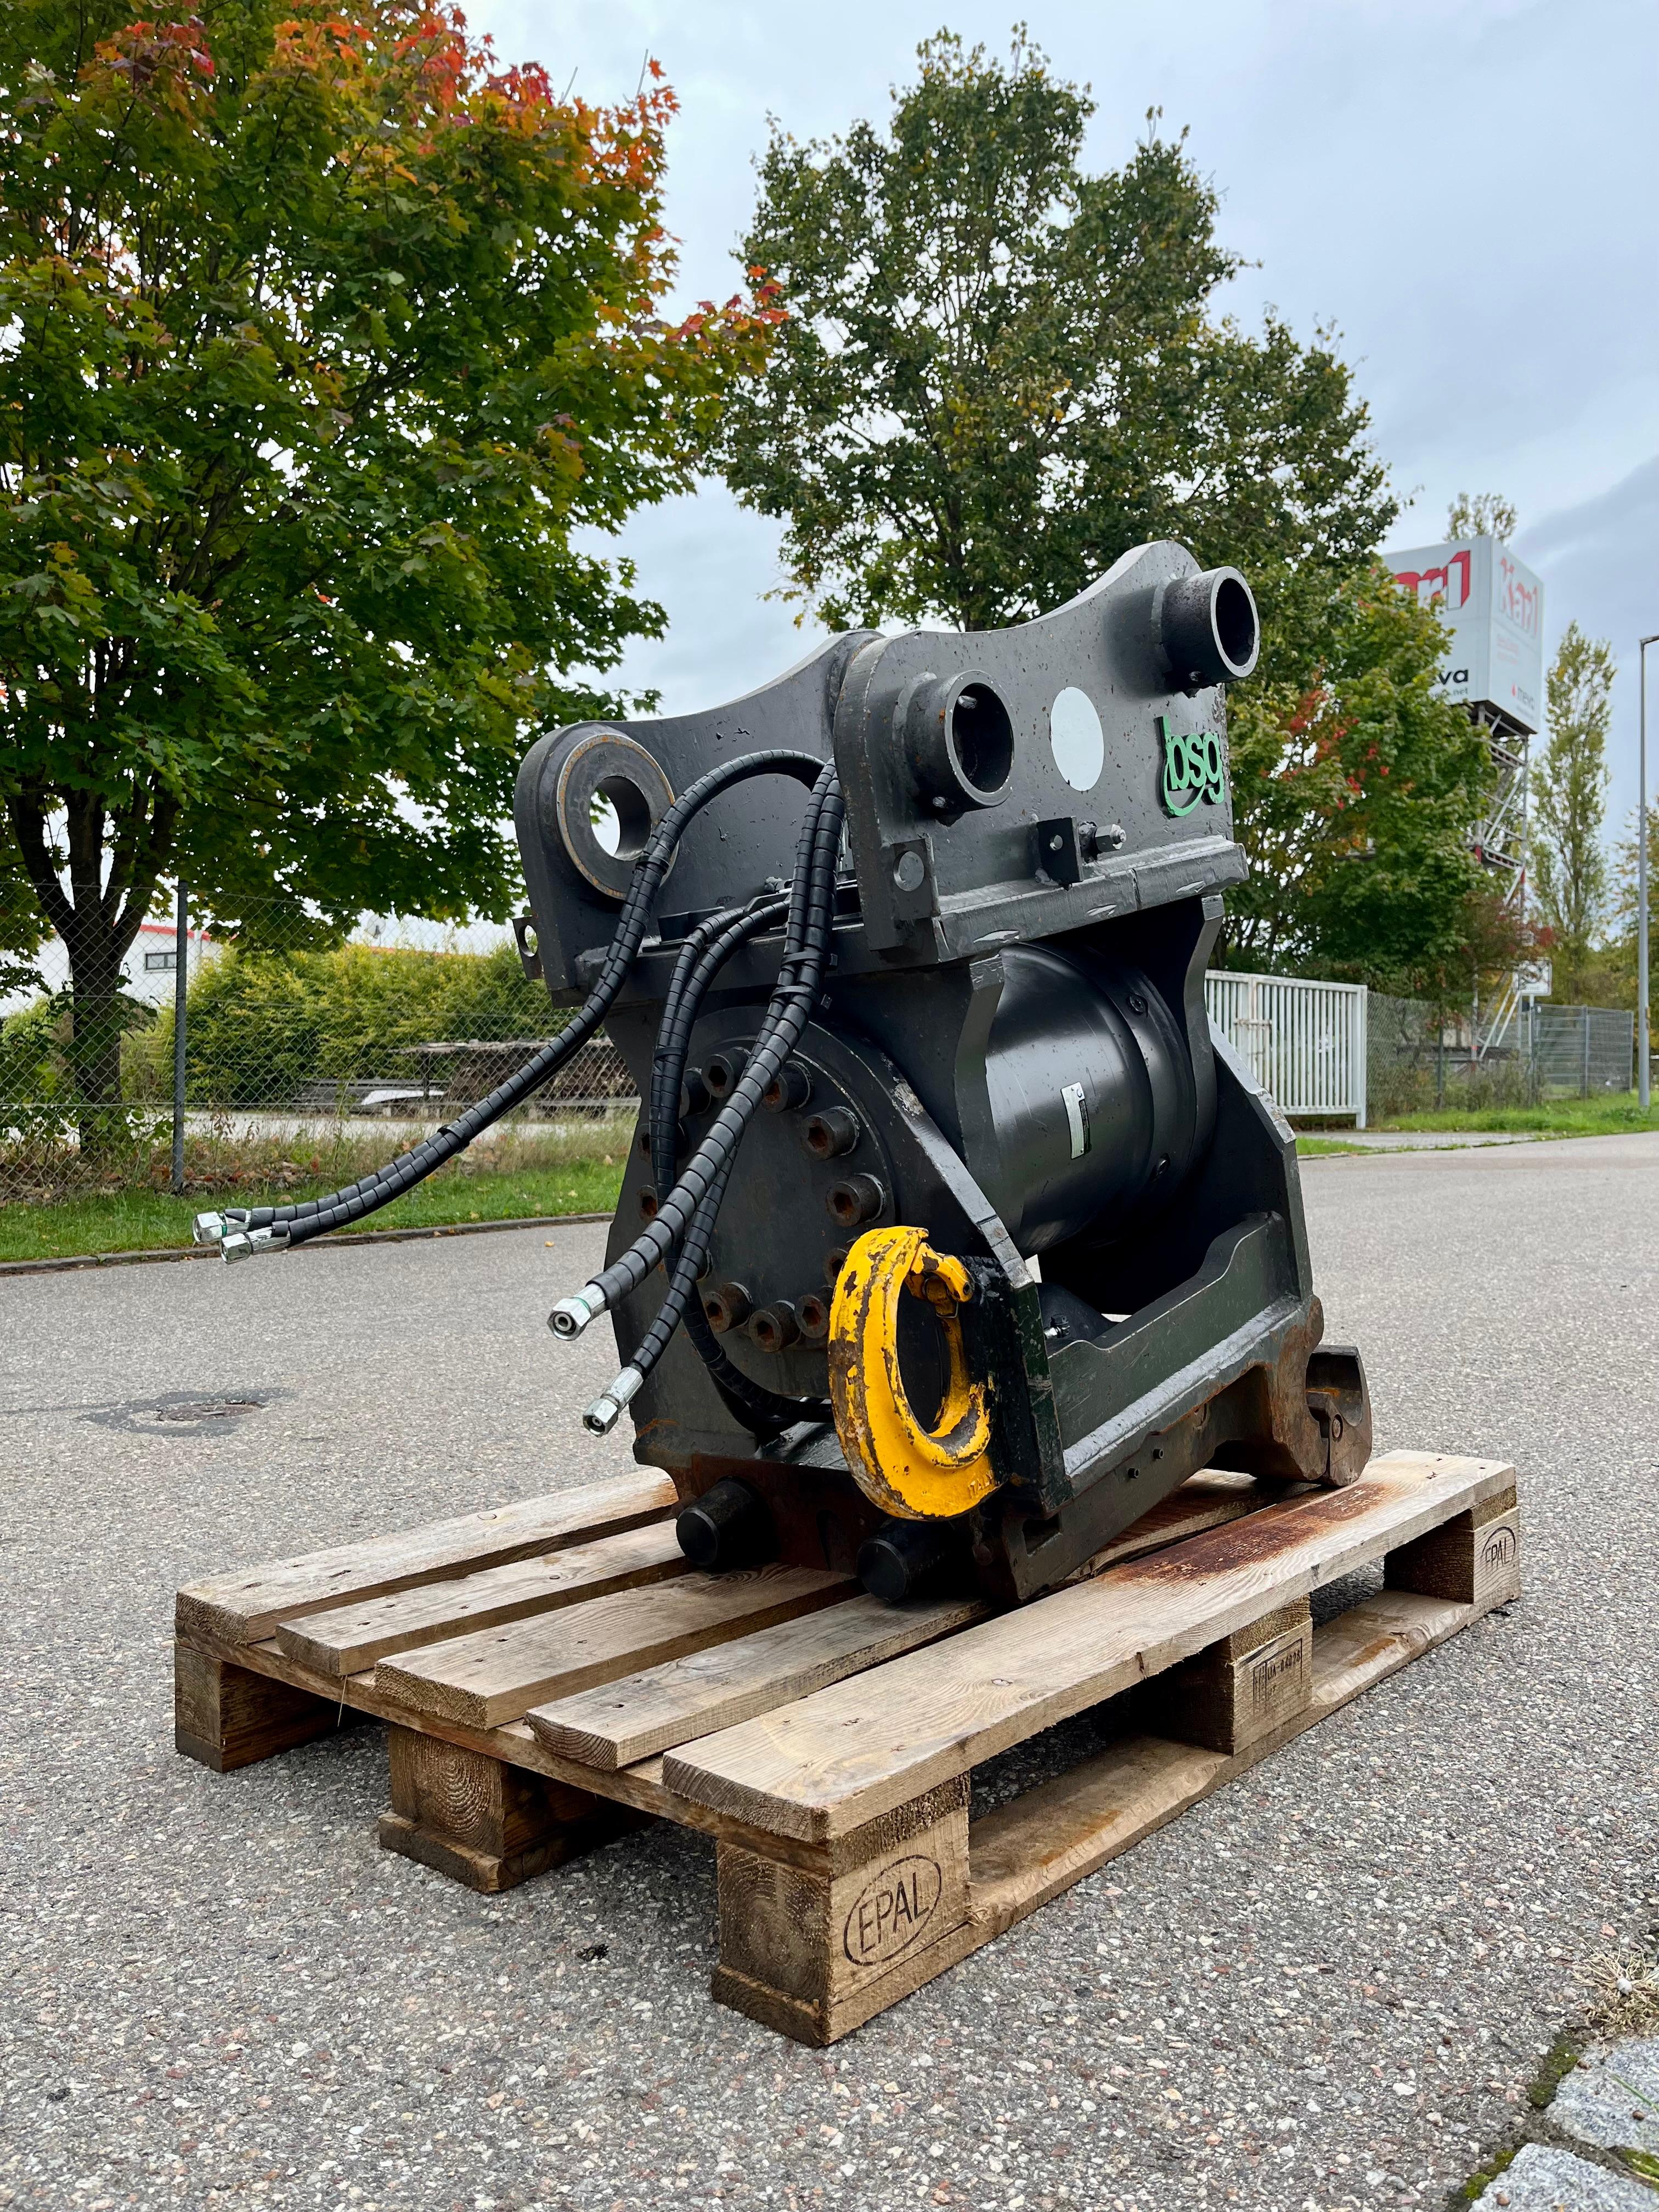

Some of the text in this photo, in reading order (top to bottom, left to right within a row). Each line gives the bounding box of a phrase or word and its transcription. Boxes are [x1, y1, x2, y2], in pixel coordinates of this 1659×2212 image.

[1163, 715, 1224, 804] bsg
[968, 1471, 992, 1499] ITALY
[859, 1872, 929, 1955] EPAL
